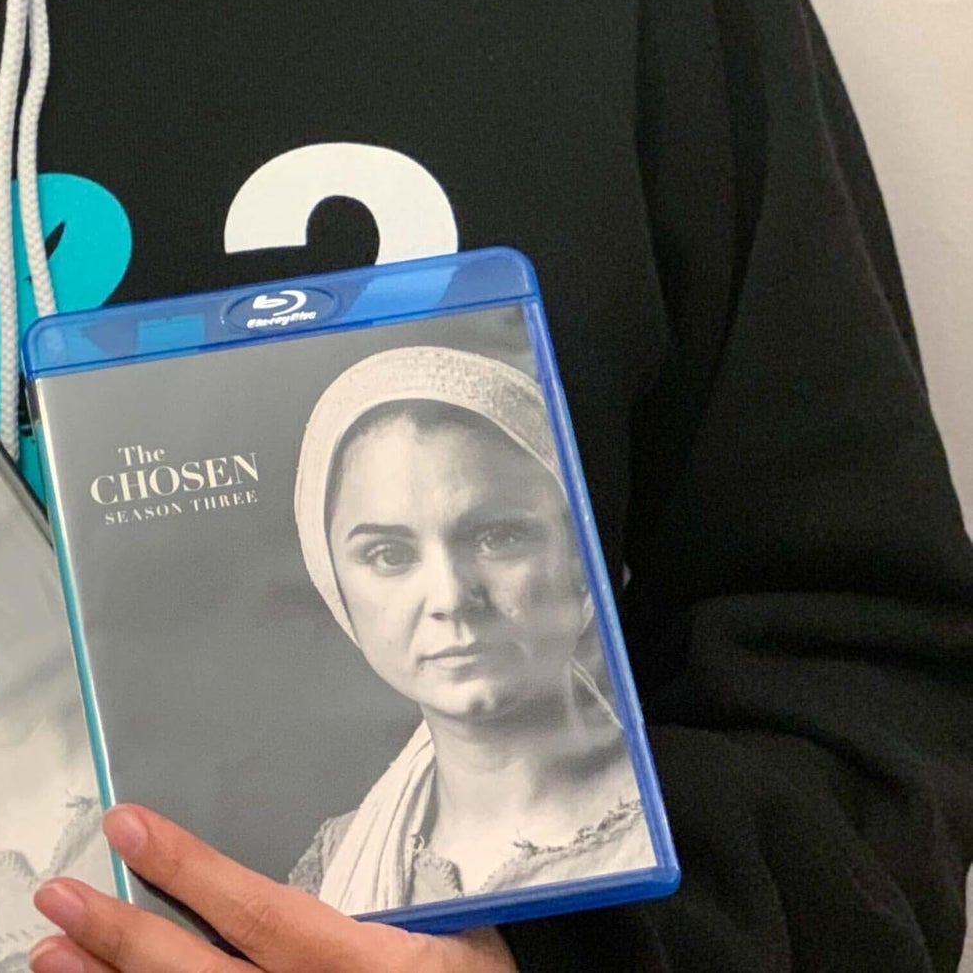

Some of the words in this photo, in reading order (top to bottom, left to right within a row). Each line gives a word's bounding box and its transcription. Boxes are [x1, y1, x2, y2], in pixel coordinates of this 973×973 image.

[117, 444, 166, 467] The
[90, 452, 259, 506] CHOSEN
[103, 502, 183, 526] SEASON
[188, 489, 259, 512] THREE
